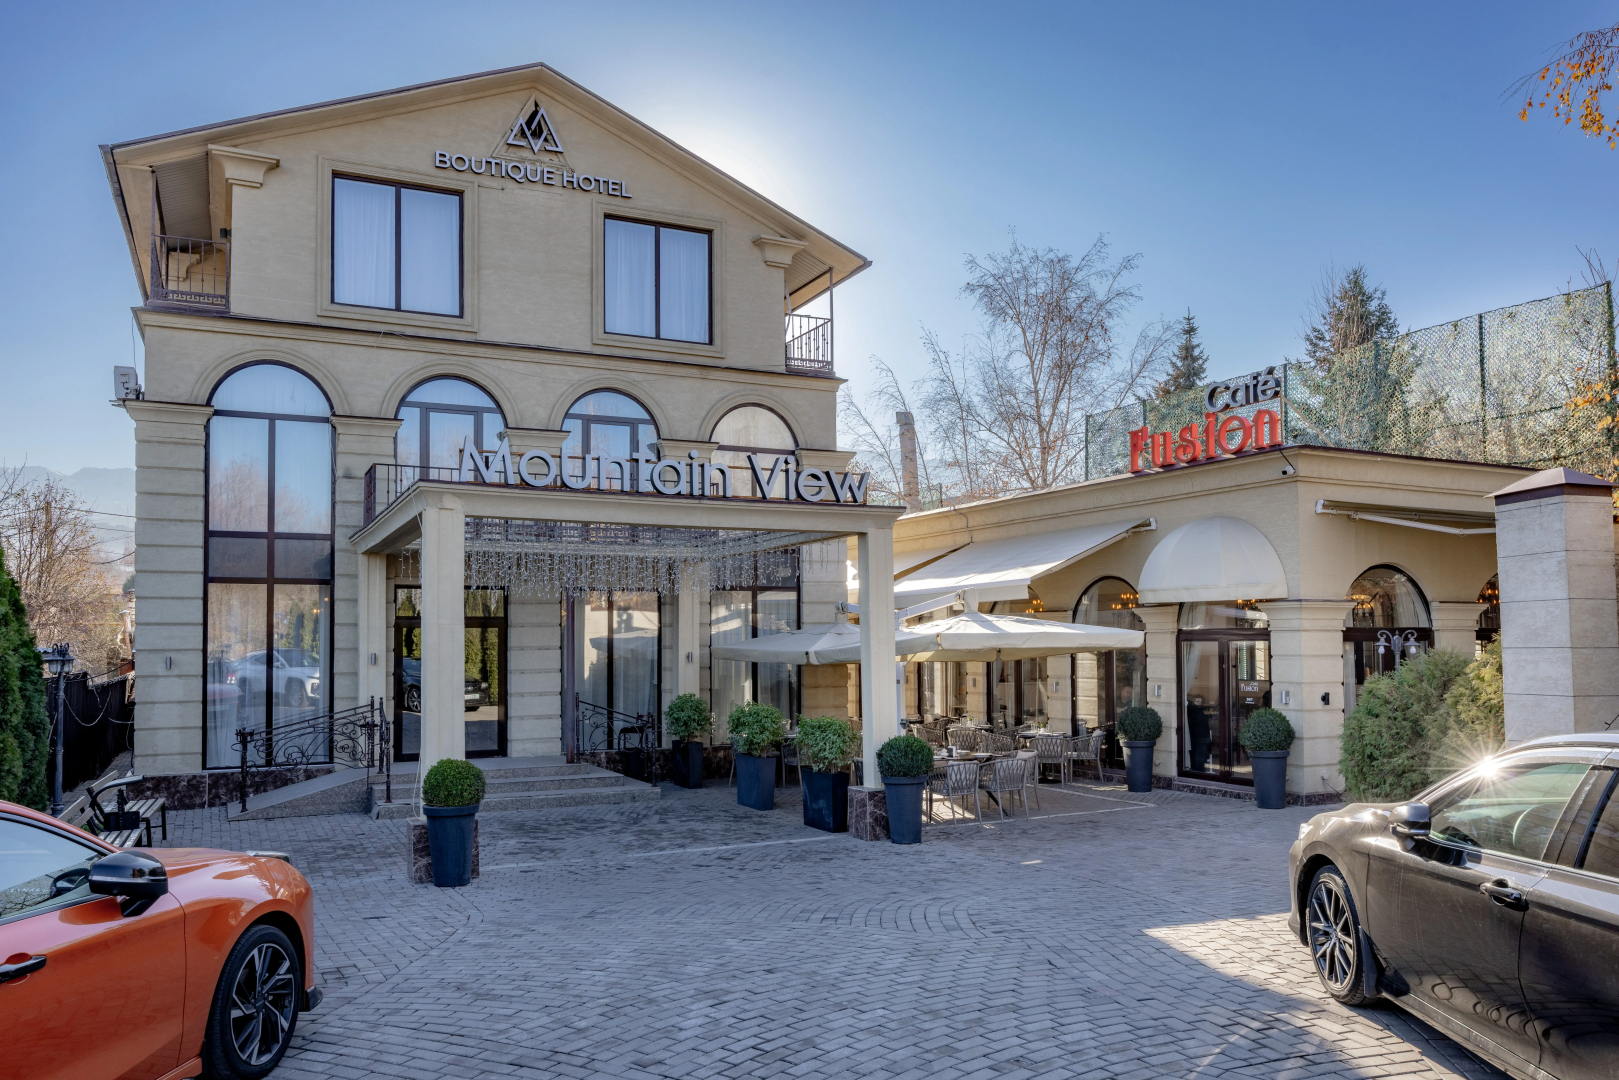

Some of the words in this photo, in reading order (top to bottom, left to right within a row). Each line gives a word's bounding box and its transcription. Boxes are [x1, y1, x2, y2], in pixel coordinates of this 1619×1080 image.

[434, 150, 556, 184] BOUTIQUE
[562, 171, 633, 198] HOTEL
[1205, 366, 1281, 413] Café
[459, 434, 732, 499] Mountain
[746, 454, 871, 503] View
[1128, 409, 1284, 473] Fusion
